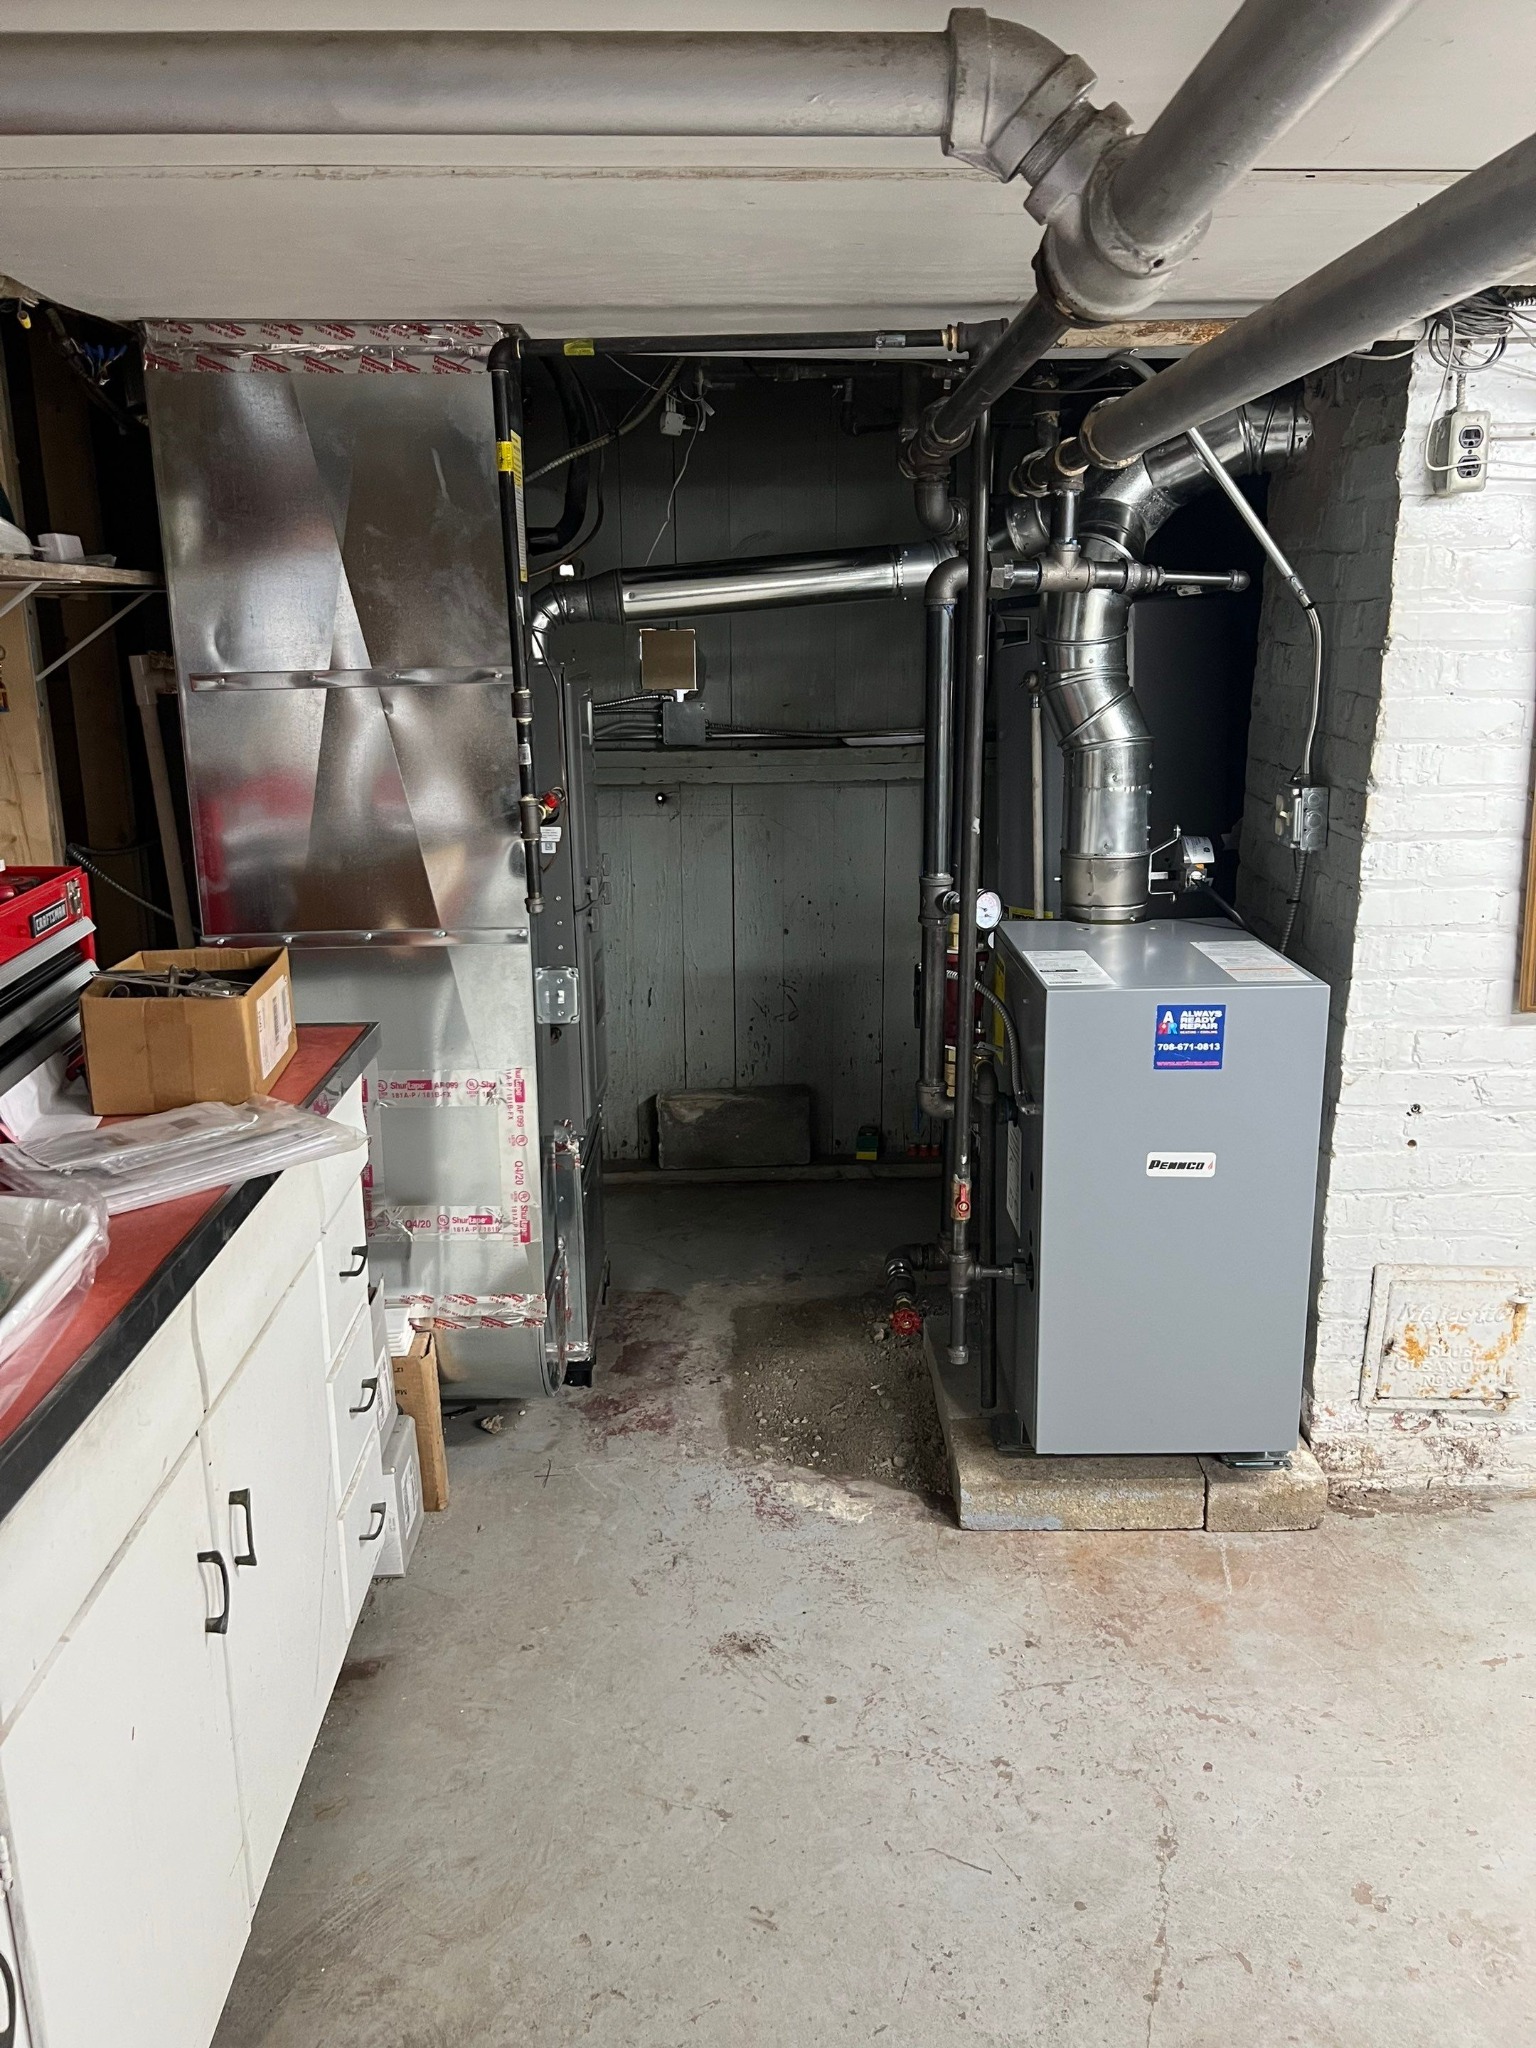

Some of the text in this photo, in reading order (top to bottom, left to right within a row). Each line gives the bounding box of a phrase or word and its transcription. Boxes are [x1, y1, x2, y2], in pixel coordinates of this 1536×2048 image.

[35, 903, 66, 931] CRAFTSMAN
[1157, 1043, 1221, 1051] 708-671-0813
[390, 1080, 432, 1091] Shurtape
[514, 1160, 524, 1186] Q4/20
[405, 1218, 431, 1228] Q4/20
[452, 1215, 493, 1225] Shurtape
[1397, 1302, 1514, 1324] Majestic
